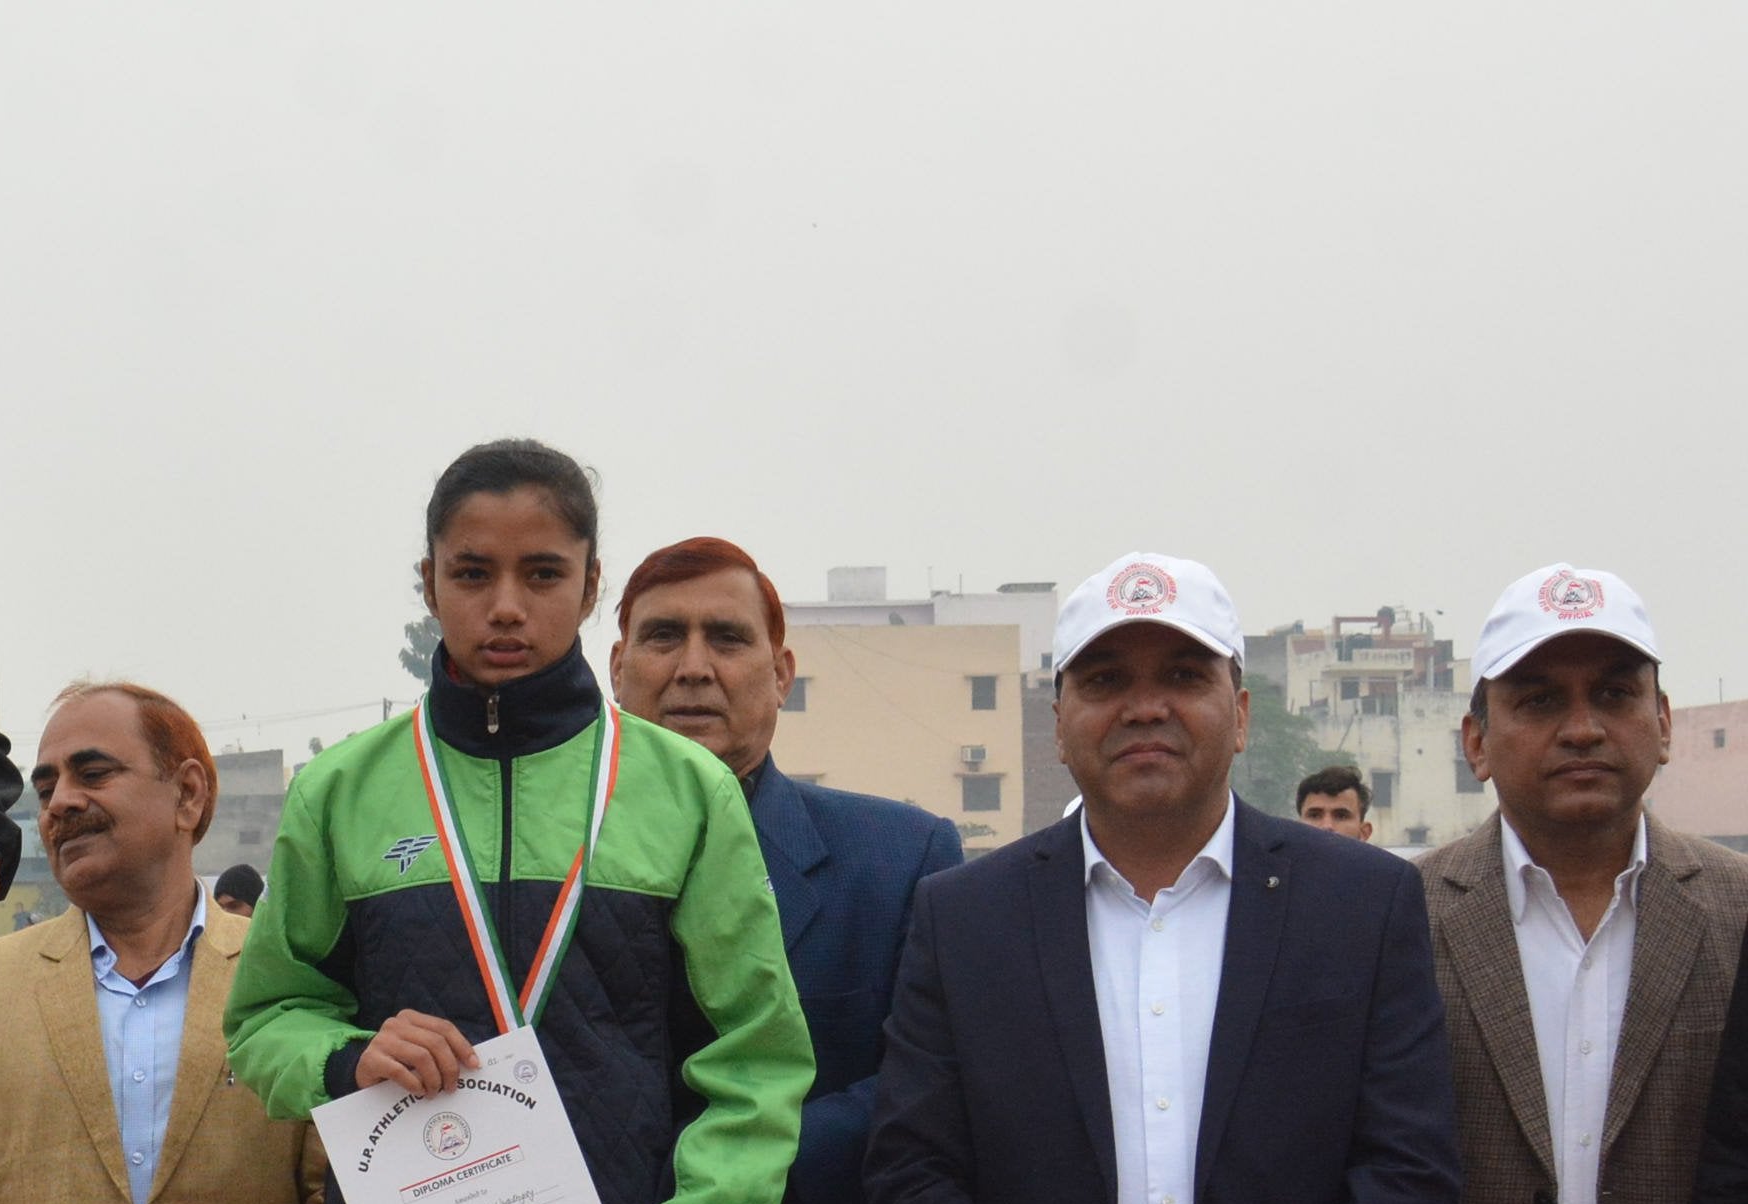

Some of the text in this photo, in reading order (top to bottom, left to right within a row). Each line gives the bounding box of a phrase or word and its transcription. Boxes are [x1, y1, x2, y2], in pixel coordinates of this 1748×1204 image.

[1557, 610, 1594, 620] OFFICIAL
[358, 1147, 375, 1173] U.P.
[413, 1153, 512, 1198] DIPLOMA CERTIFICATE
